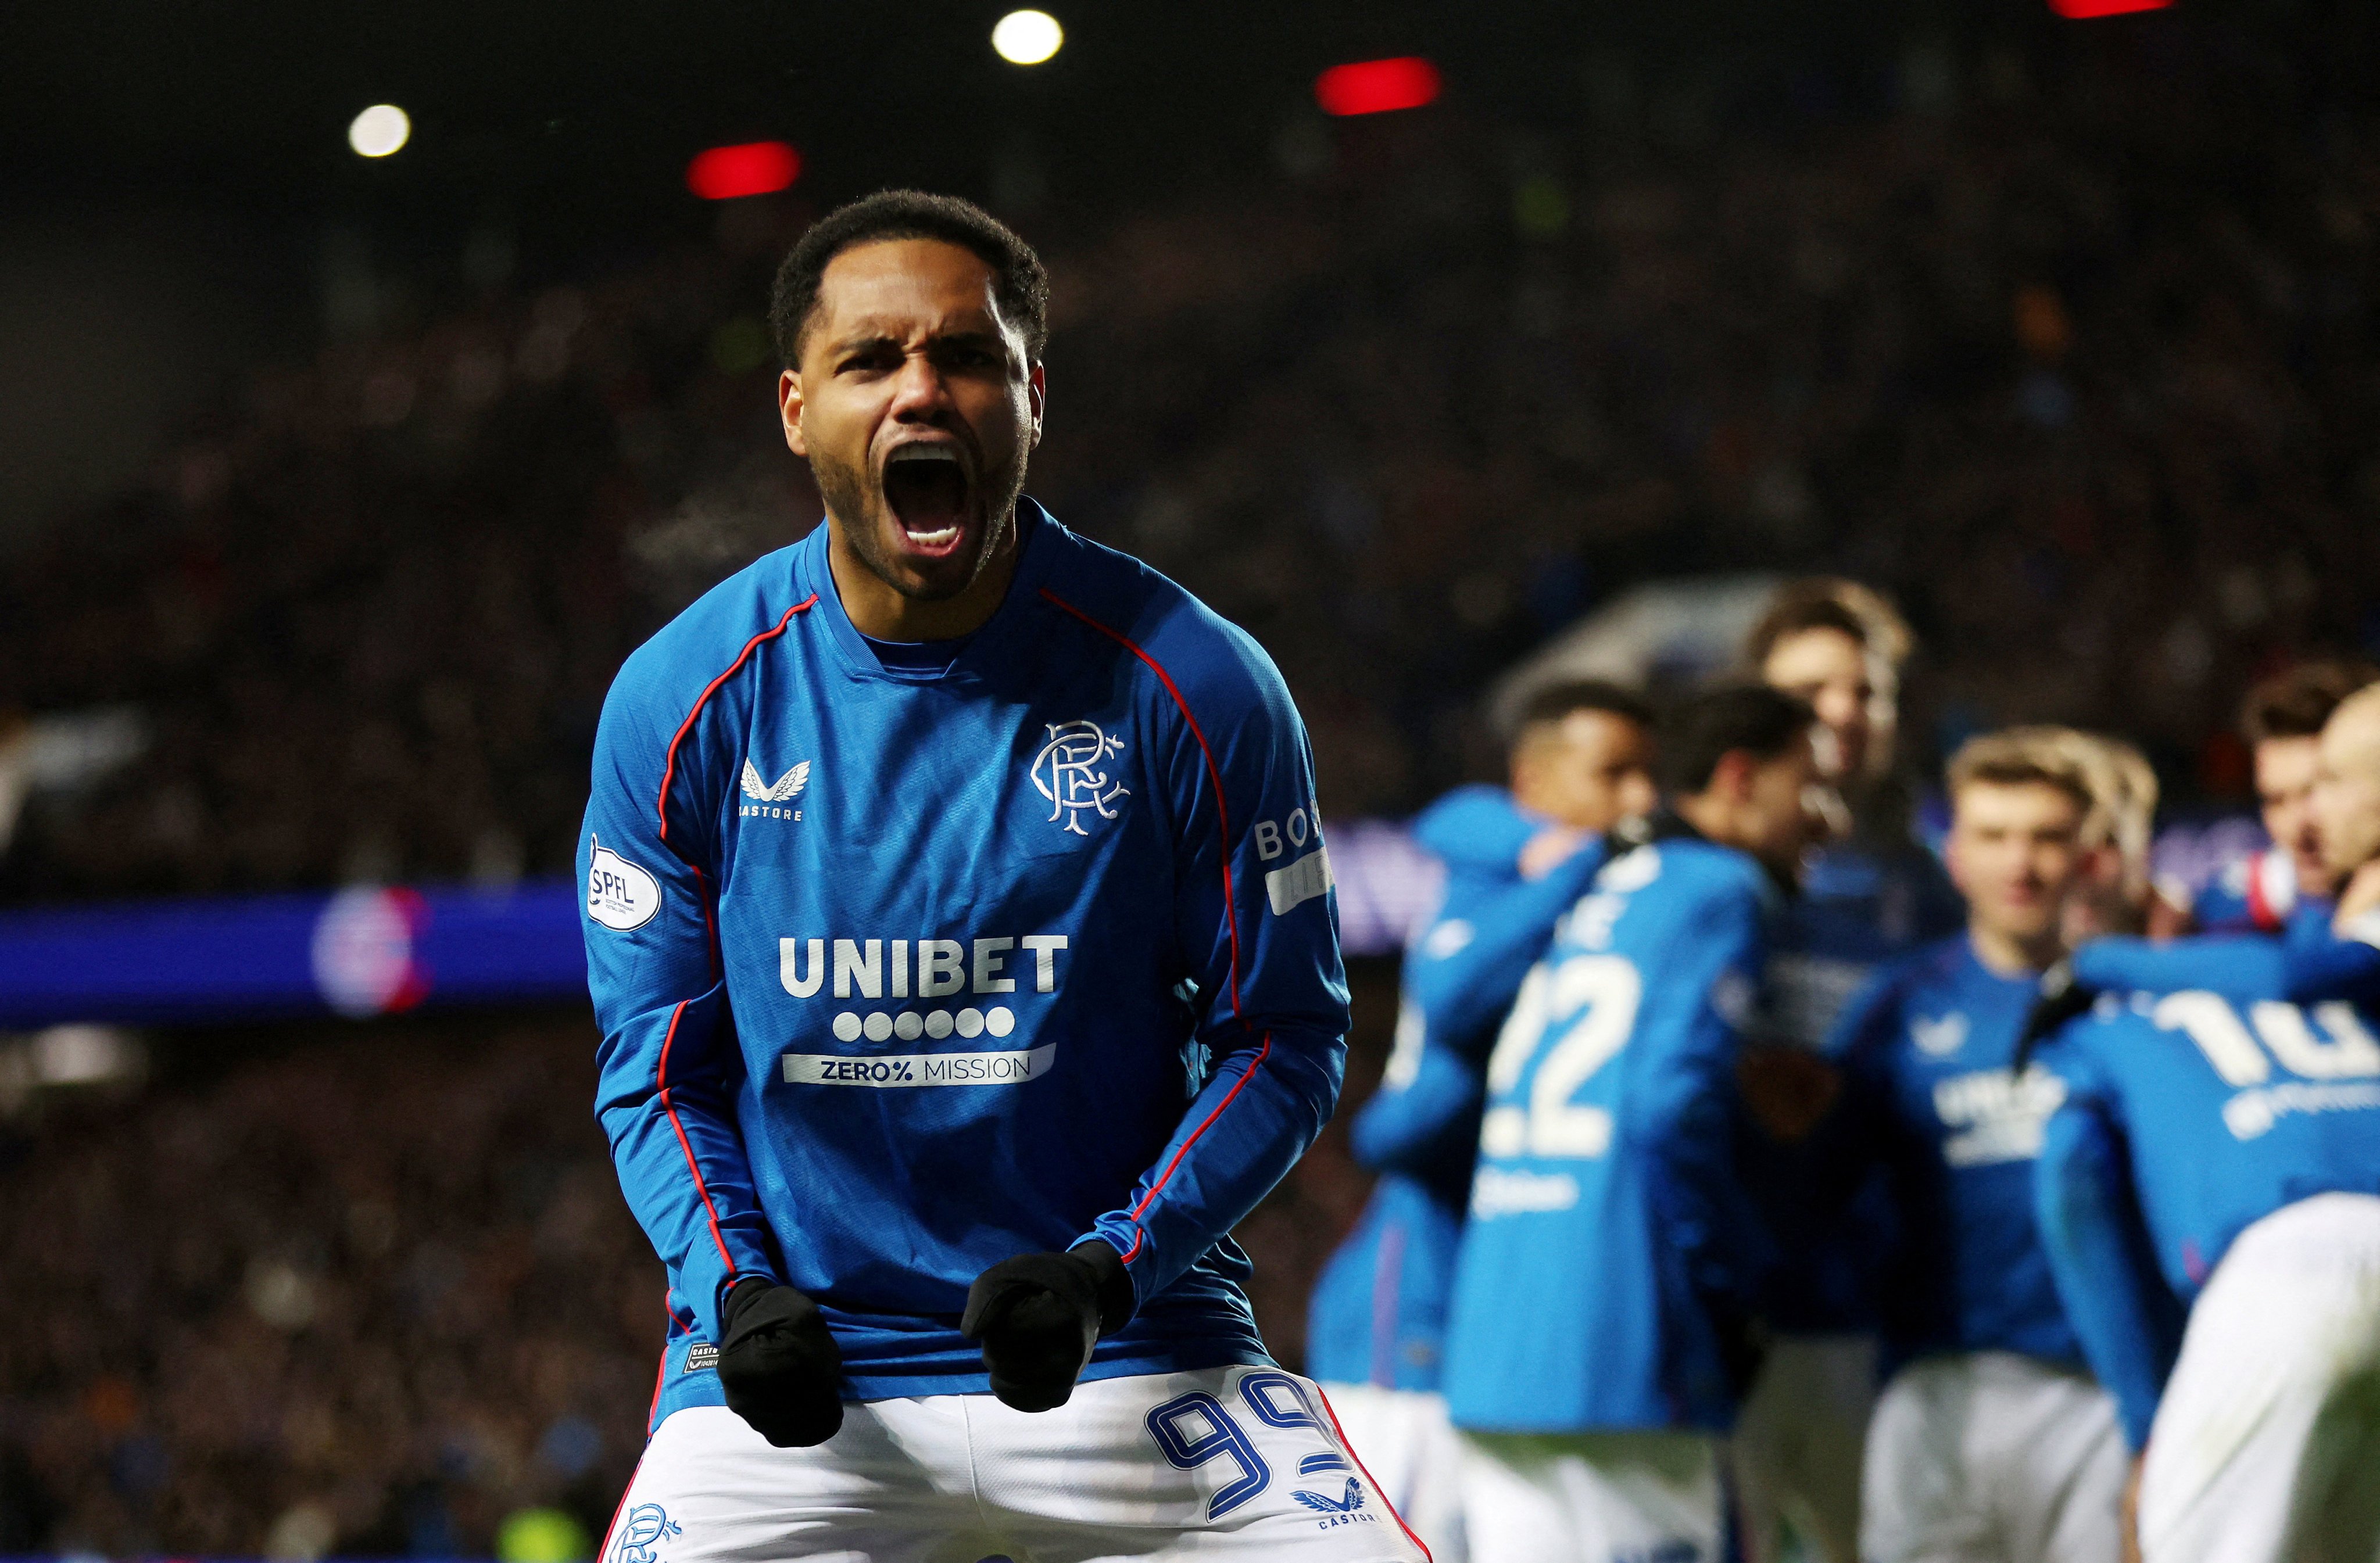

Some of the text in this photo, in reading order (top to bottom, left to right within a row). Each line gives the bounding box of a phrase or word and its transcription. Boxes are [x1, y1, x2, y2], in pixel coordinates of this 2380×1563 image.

[592, 869, 634, 904] SPFL
[779, 935, 1068, 998] UNIBET
[821, 1056, 1030, 1081] ZERO% MISSION
[1144, 1371, 1355, 1523] 99
